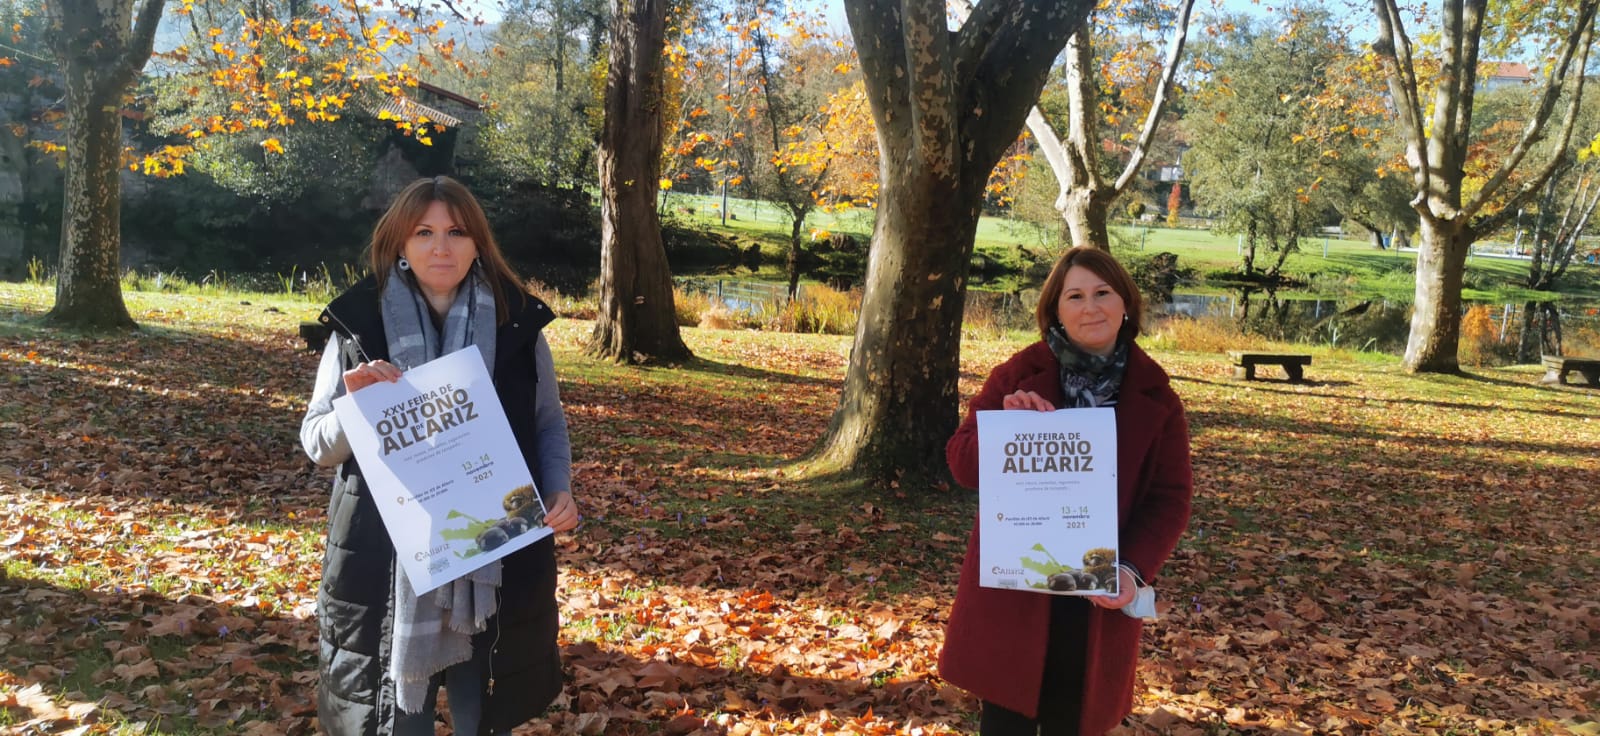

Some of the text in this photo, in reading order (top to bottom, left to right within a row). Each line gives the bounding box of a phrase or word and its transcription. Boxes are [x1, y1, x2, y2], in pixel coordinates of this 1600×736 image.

[382, 383, 454, 418] XXV FEIRA DE
[376, 388, 469, 436] OUTONO
[383, 401, 479, 457] ALLARIZ
[415, 422, 425, 431] DE
[1014, 432, 1081, 442] XXV FEIRA DE
[1004, 440, 1092, 457] OUTONO
[461, 460, 473, 471] 13
[479, 453, 490, 465] 14
[1002, 455, 1094, 474] ALLARIZ
[473, 469, 494, 484] 2021
[1061, 506, 1071, 515] 13
[1079, 506, 1089, 514] 14
[1066, 521, 1086, 529] 2021
[999, 567, 1025, 576] Allariz
